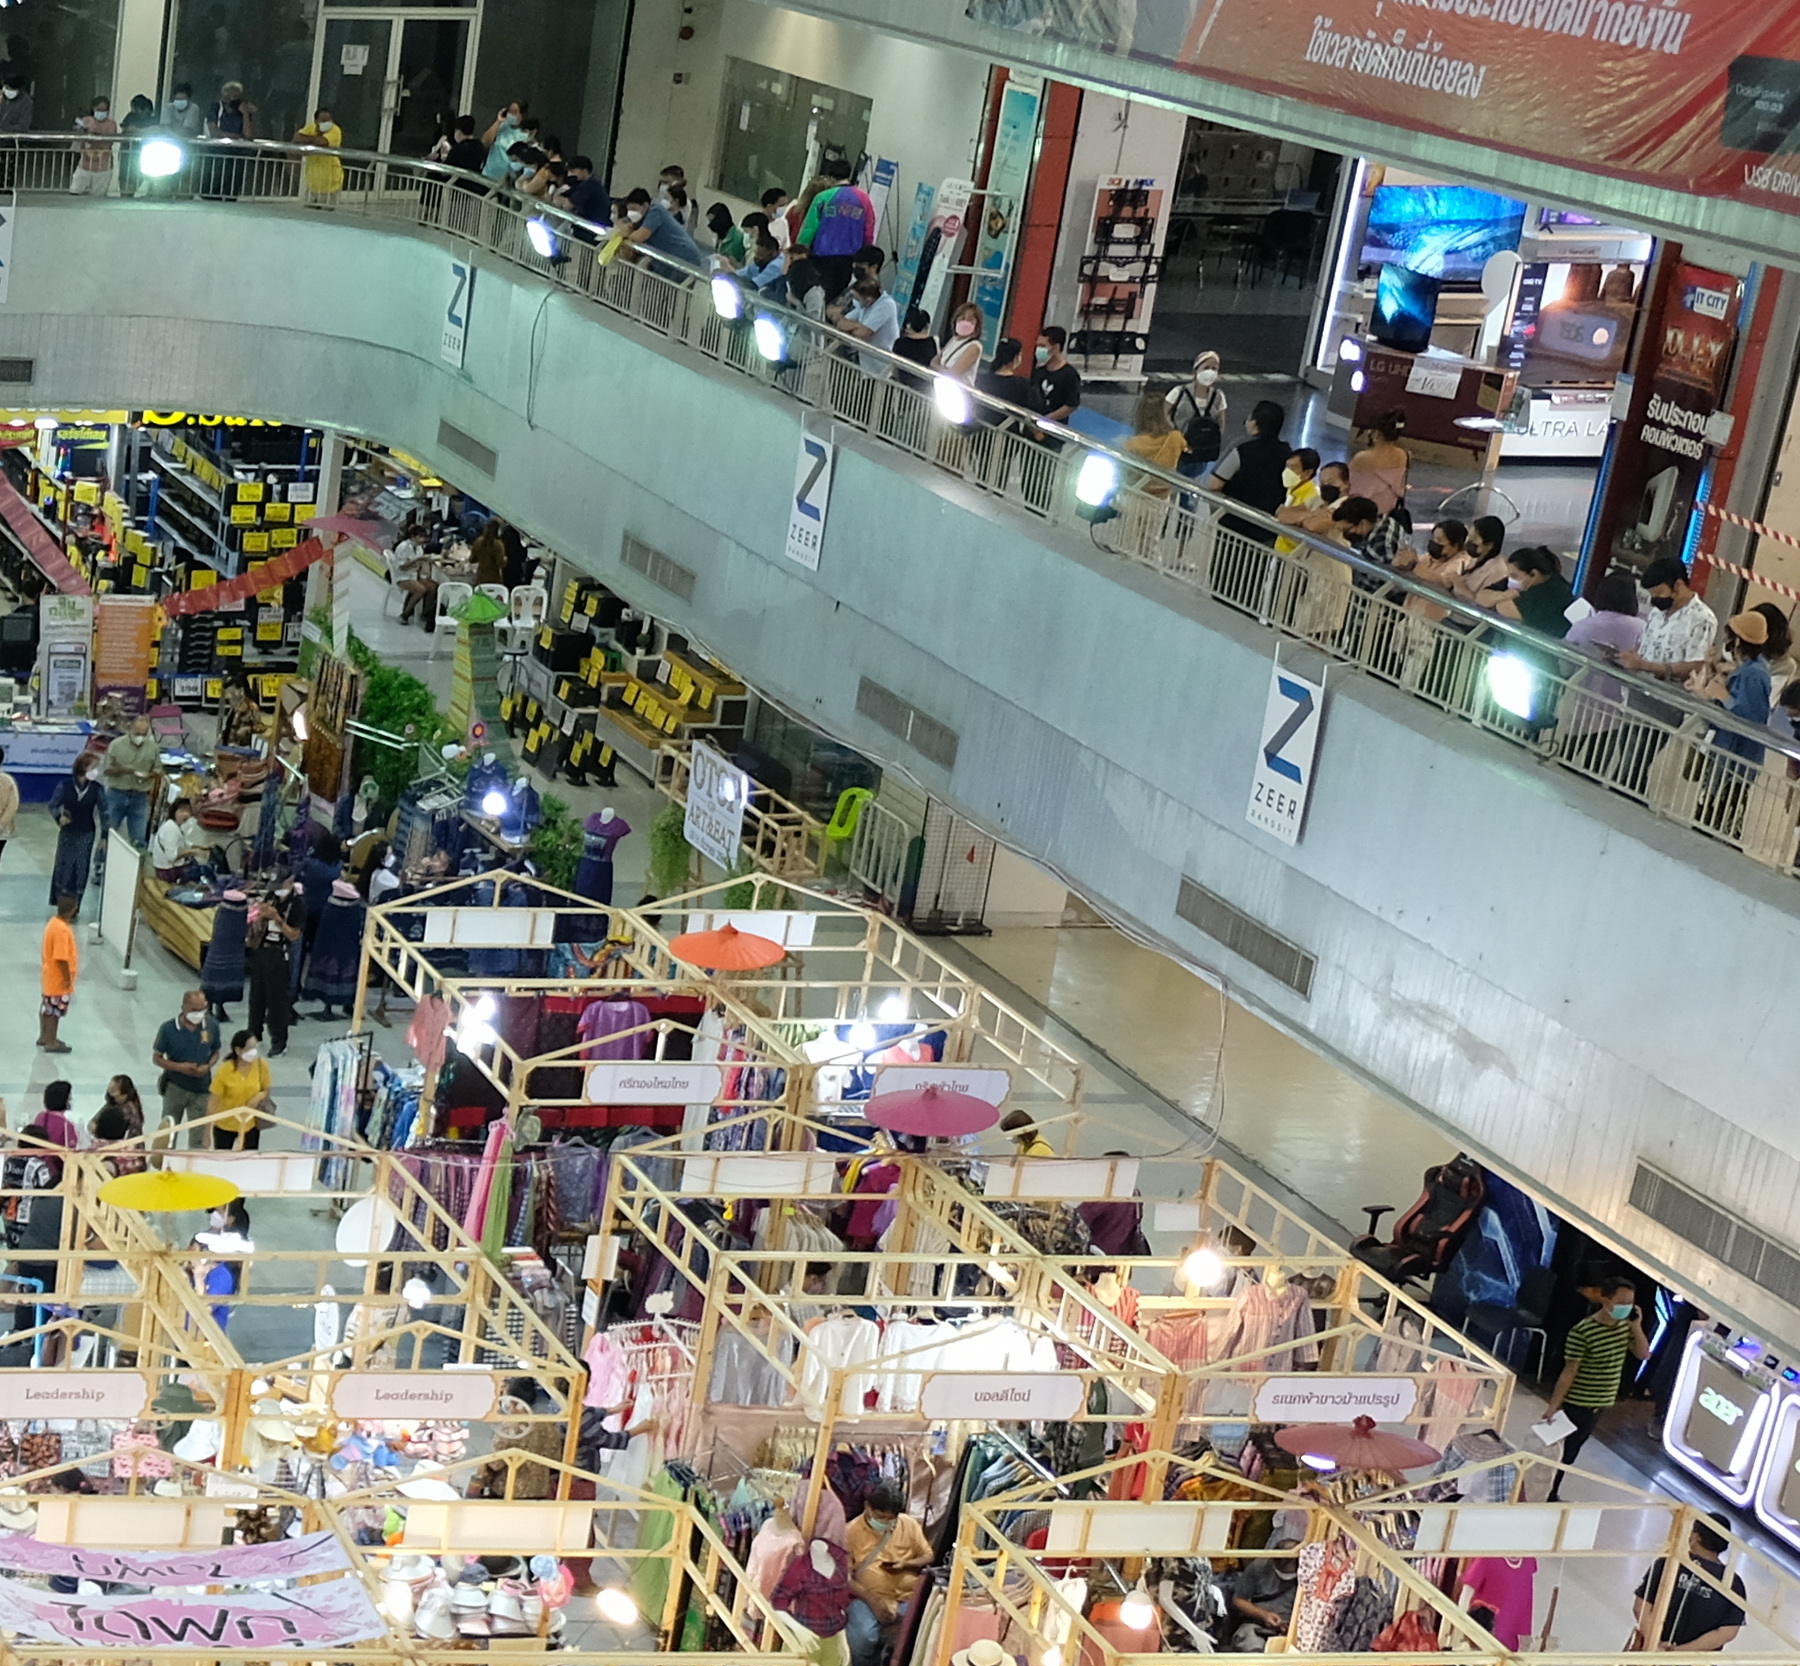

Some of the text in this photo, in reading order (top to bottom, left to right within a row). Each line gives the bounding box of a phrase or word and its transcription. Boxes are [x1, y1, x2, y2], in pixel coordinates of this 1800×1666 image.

[1695, 291, 1728, 311] IT CITY
[443, 332, 461, 352] ZEER
[790, 523, 818, 551] ZEER
[1254, 782, 1298, 822] ZEER
[25, 1387, 106, 1402] Leadership
[374, 1388, 454, 1404] Leadership
